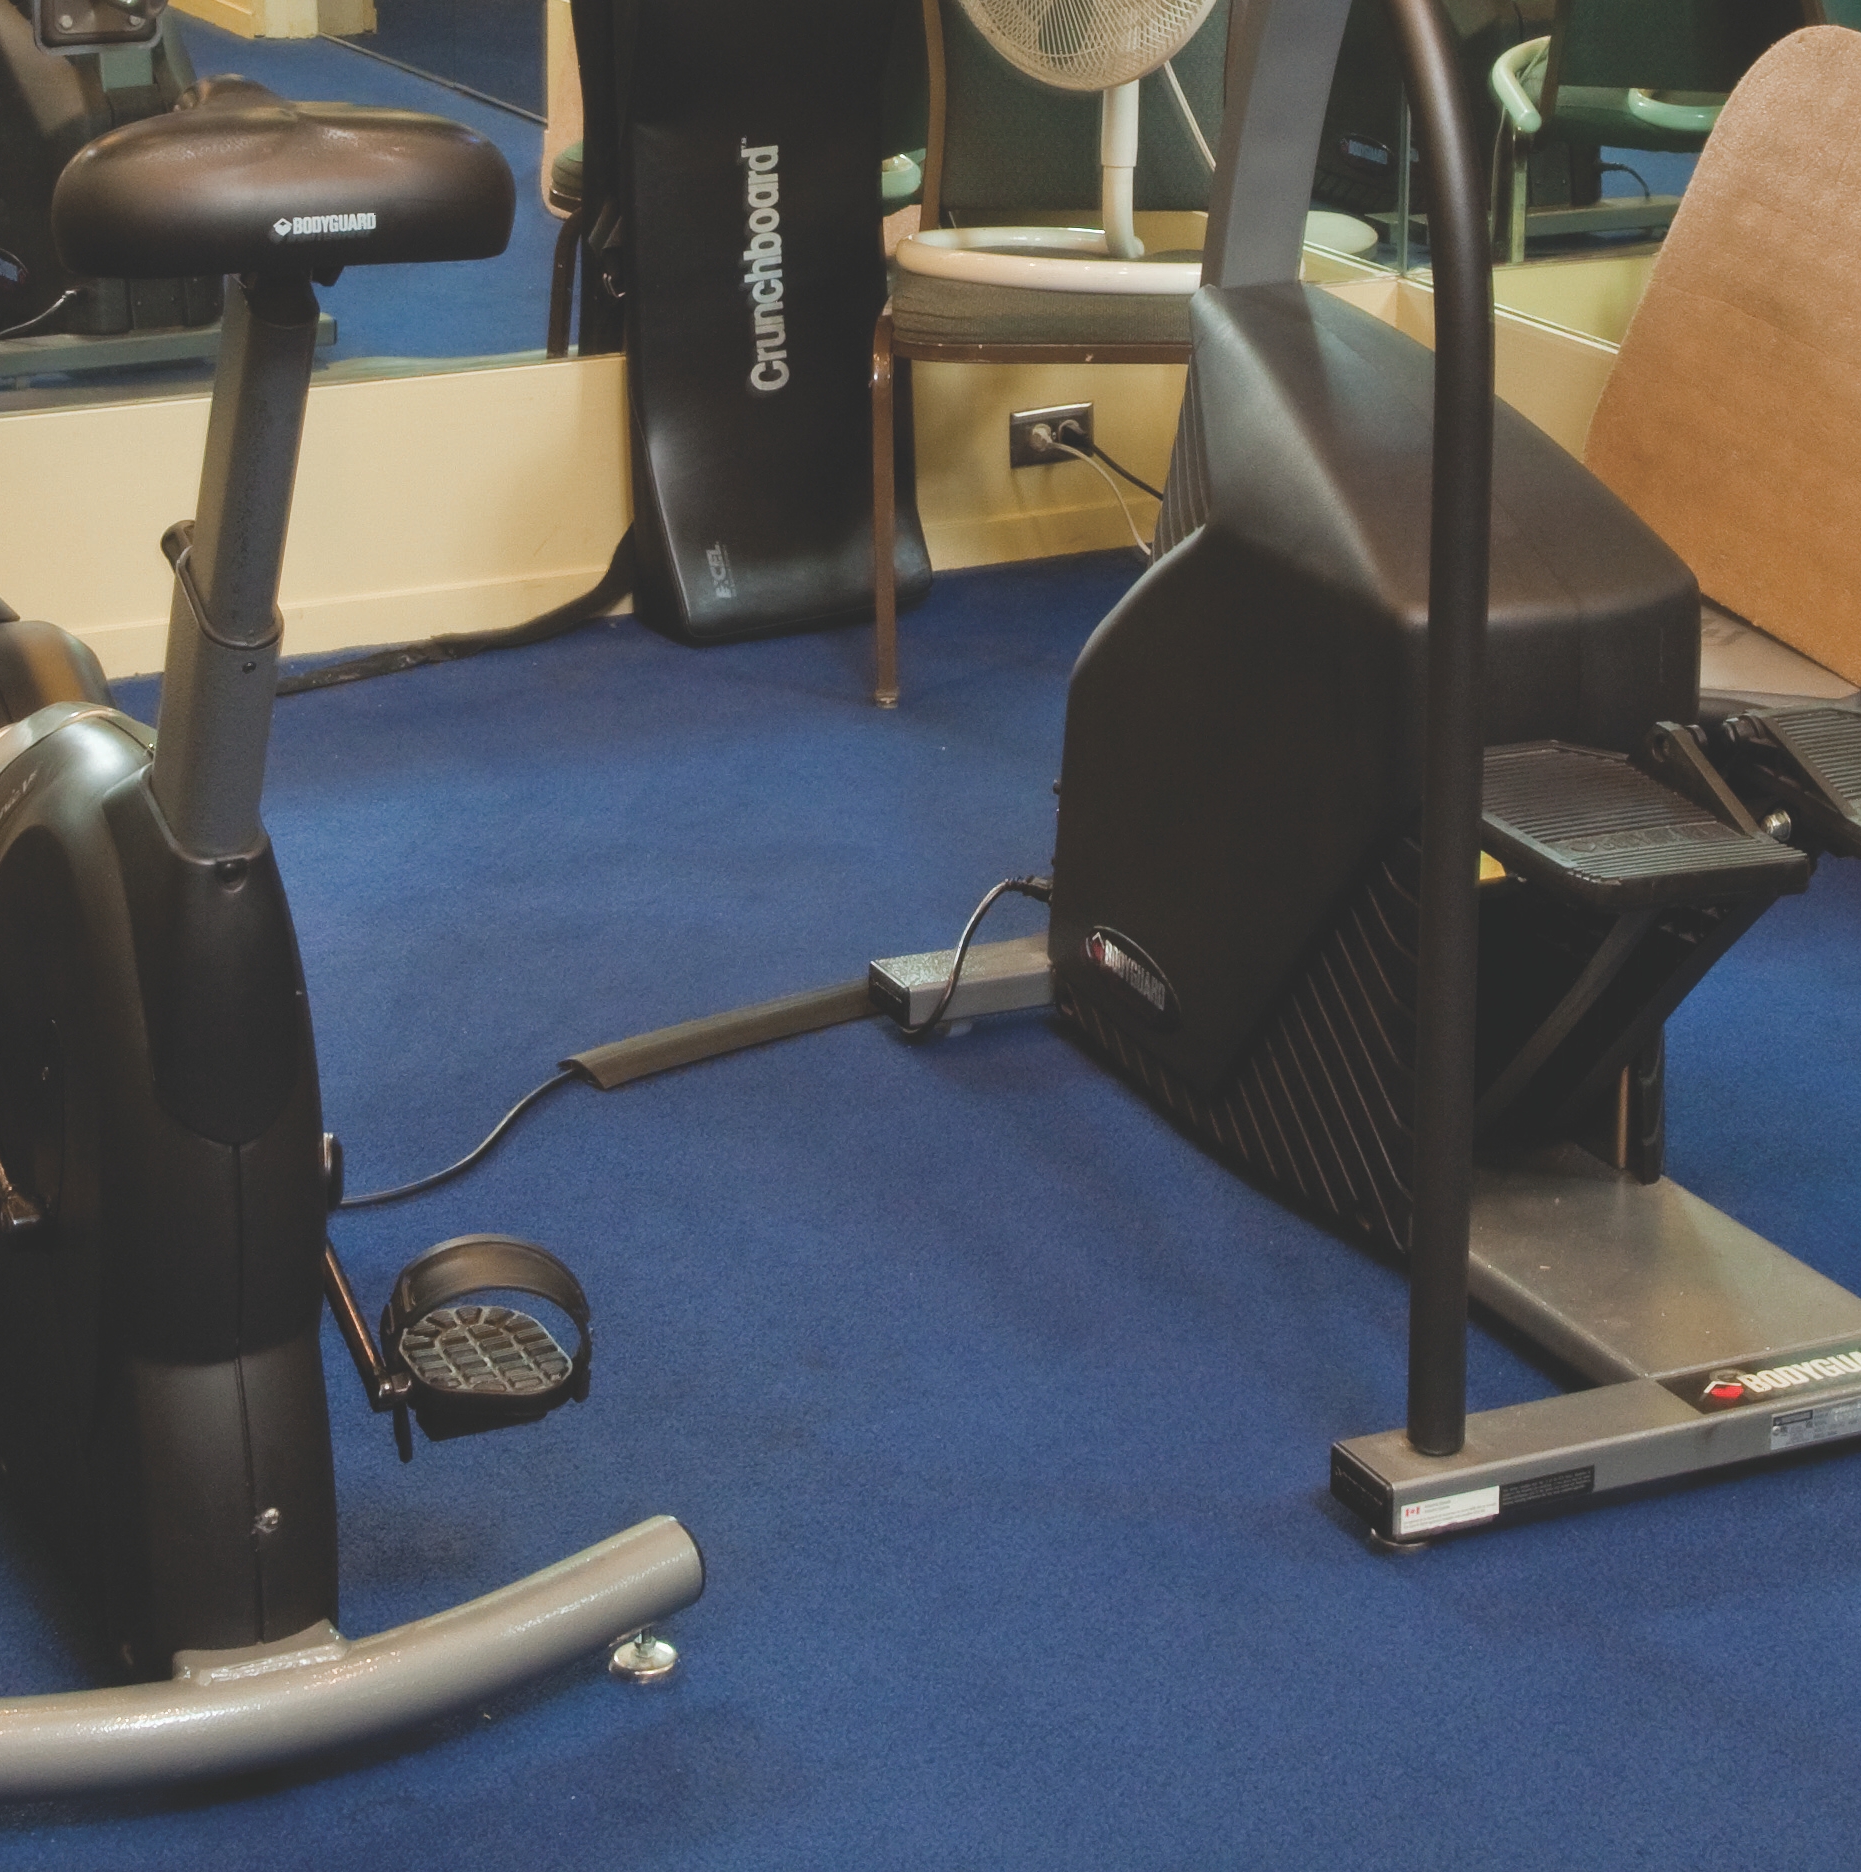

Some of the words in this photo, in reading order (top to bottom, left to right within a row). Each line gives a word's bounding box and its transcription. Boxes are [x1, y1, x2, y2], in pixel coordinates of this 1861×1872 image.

[292, 212, 377, 236] BODYGUARD
[744, 143, 790, 392] Crunchboard
[1104, 938, 1166, 1012] BODYGUARD
